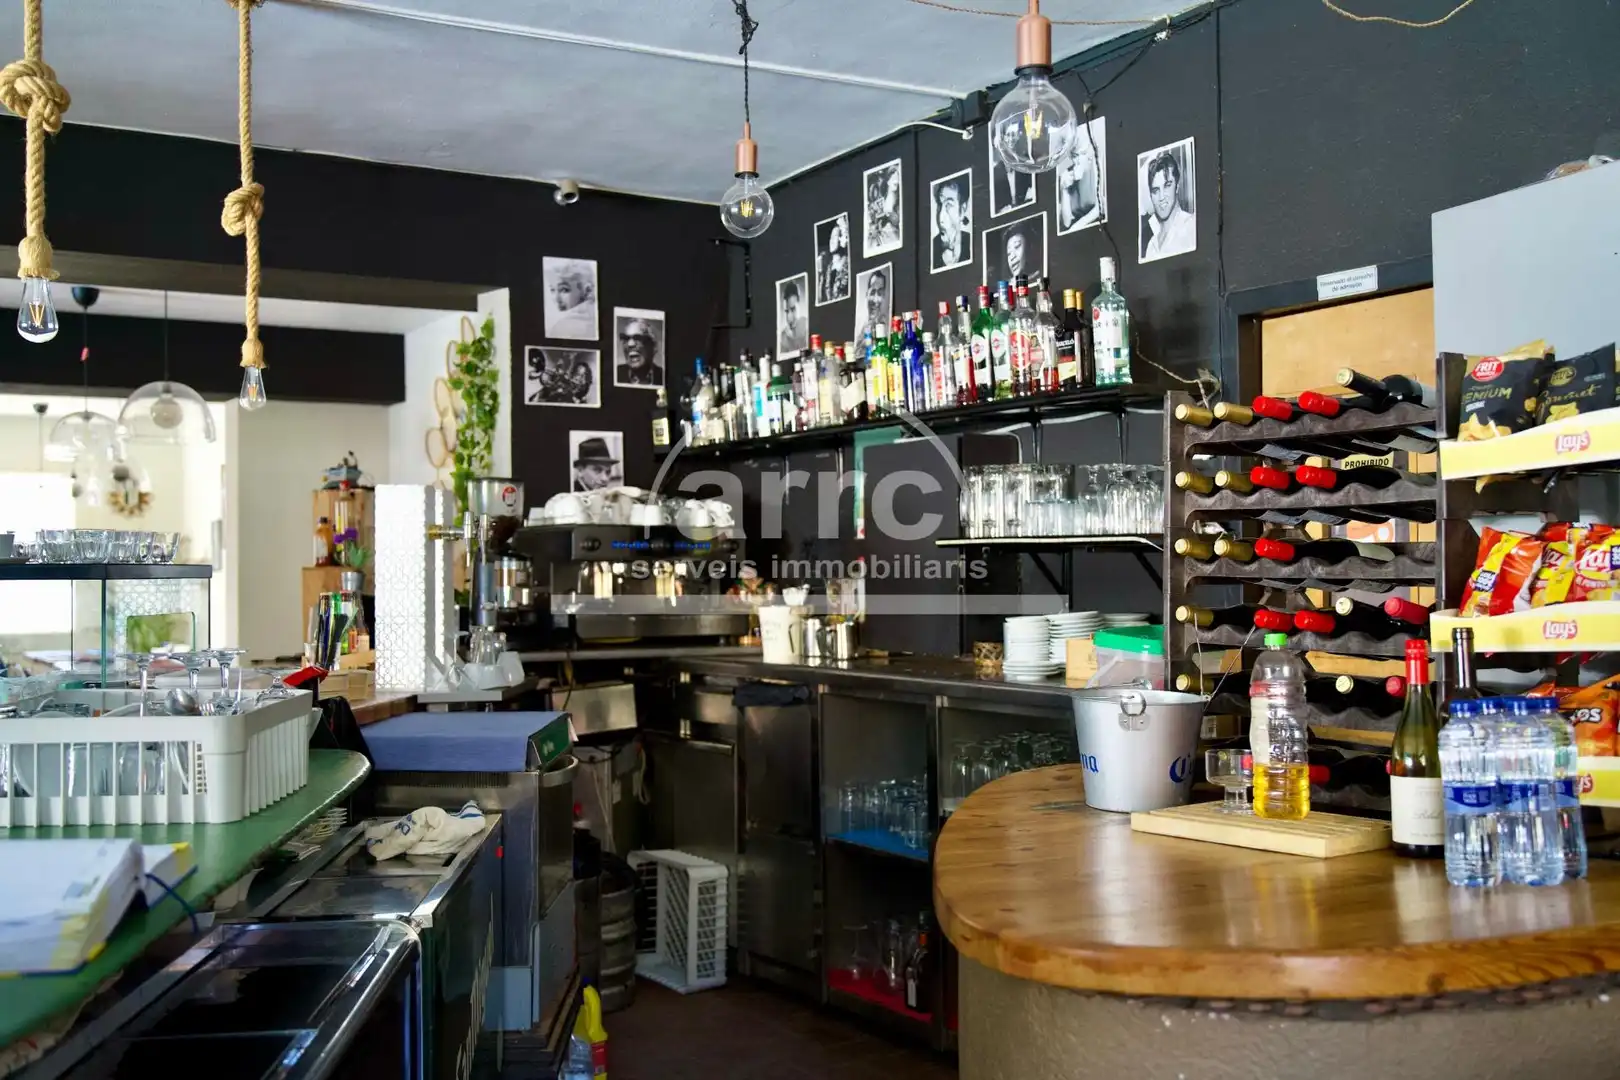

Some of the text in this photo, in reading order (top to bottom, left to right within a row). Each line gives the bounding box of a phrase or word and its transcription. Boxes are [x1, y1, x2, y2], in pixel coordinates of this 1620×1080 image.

[1461, 387, 1512, 401] EMIUM
[1344, 457, 1390, 469] PROHIBIDO
[1081, 753, 1099, 773] na
